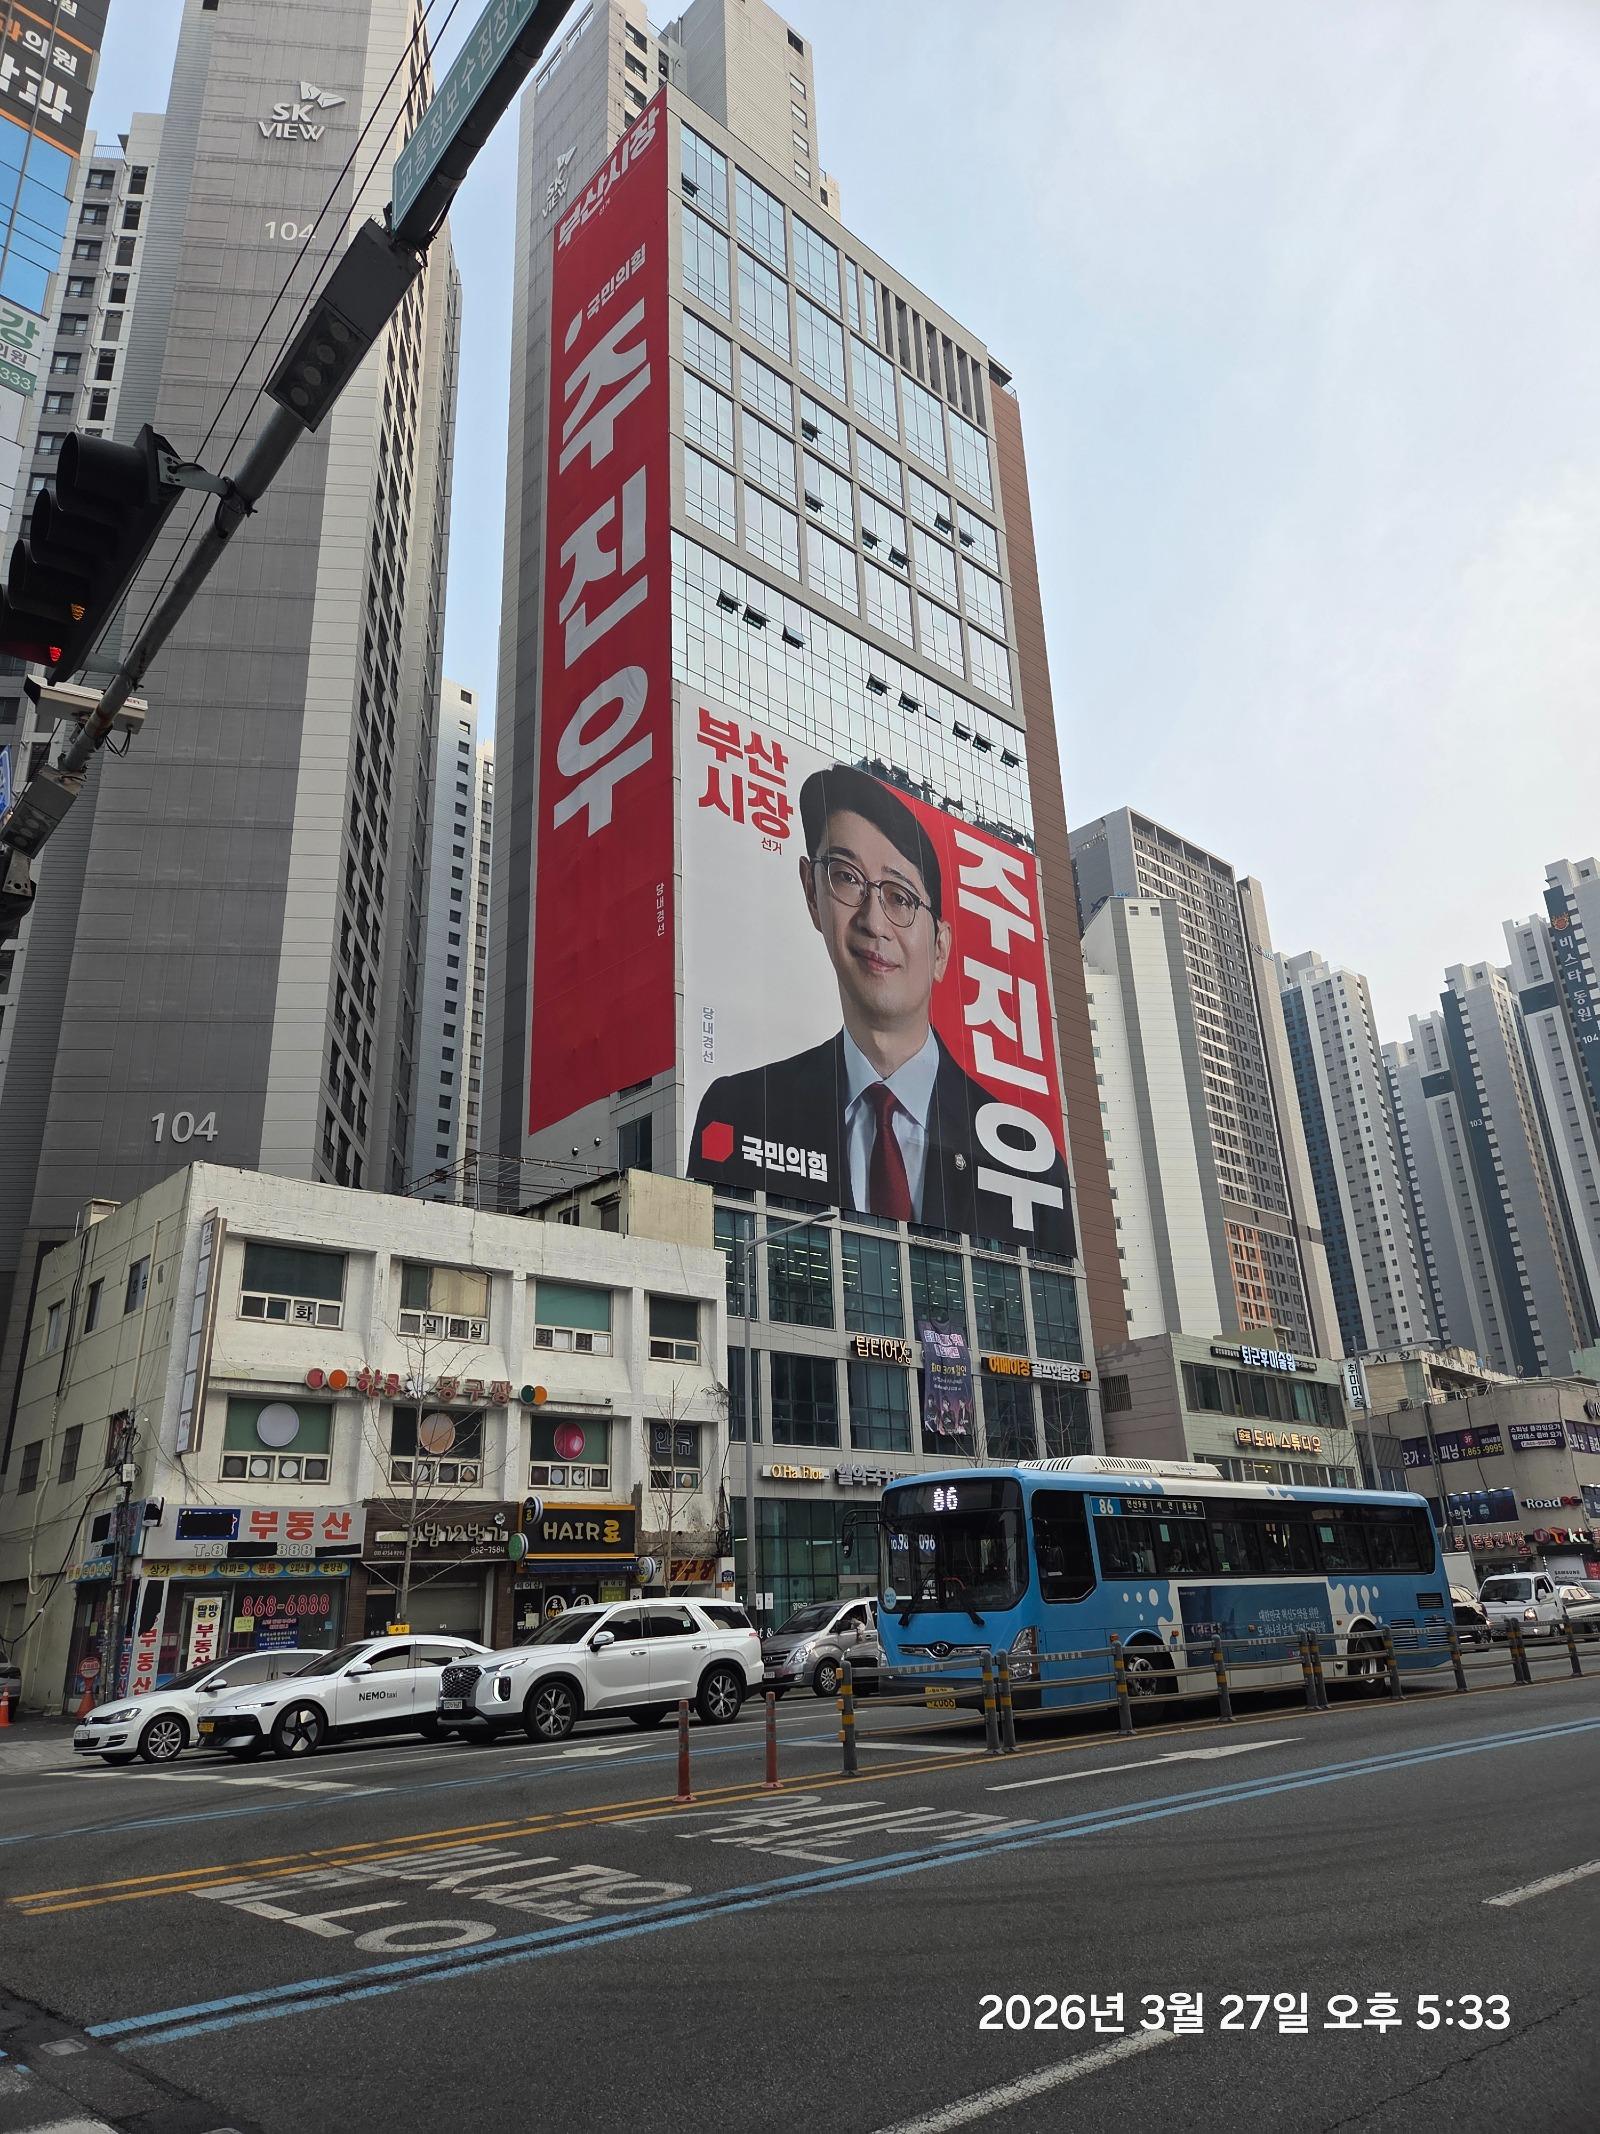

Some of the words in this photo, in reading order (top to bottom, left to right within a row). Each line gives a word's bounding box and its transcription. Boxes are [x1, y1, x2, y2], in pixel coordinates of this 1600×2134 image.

[272, 103, 314, 123] SK
[258, 121, 325, 142] VIEW
[546, 170, 565, 200] SK
[541, 178, 568, 218] VIEW
[265, 221, 316, 241] 104
[587, 243, 646, 319] 국민의힘
[553, 298, 653, 836] 주진우
[697, 707, 789, 787] 부산
[698, 765, 794, 839] 시장
[761, 837, 782, 855] 선거
[656, 882, 665, 937] 당내경선
[702, 1006, 715, 1064] 당내경선
[953, 829, 1064, 1232] 주진우
[151, 1111, 218, 1143] 104
[741, 1135, 828, 1182] 국민의힘
[989, 1355, 1032, 1377] 어메이징
[1281, 1432, 1323, 1453] 스튜디오
[933, 1486, 958, 1511] 86
[1099, 1498, 1114, 1514] 86
[249, 1511, 352, 1540] 부동산
[543, 1521, 600, 1542] HAIR
[149, 1563, 170, 1575] 상가
[187, 1563, 207, 1574] 주택
[220, 1563, 245, 1574] 아파트
[242, 1594, 330, 1617] 868-6888
[359, 1691, 386, 1702] NEMO
[387, 1691, 398, 1699] taxi
